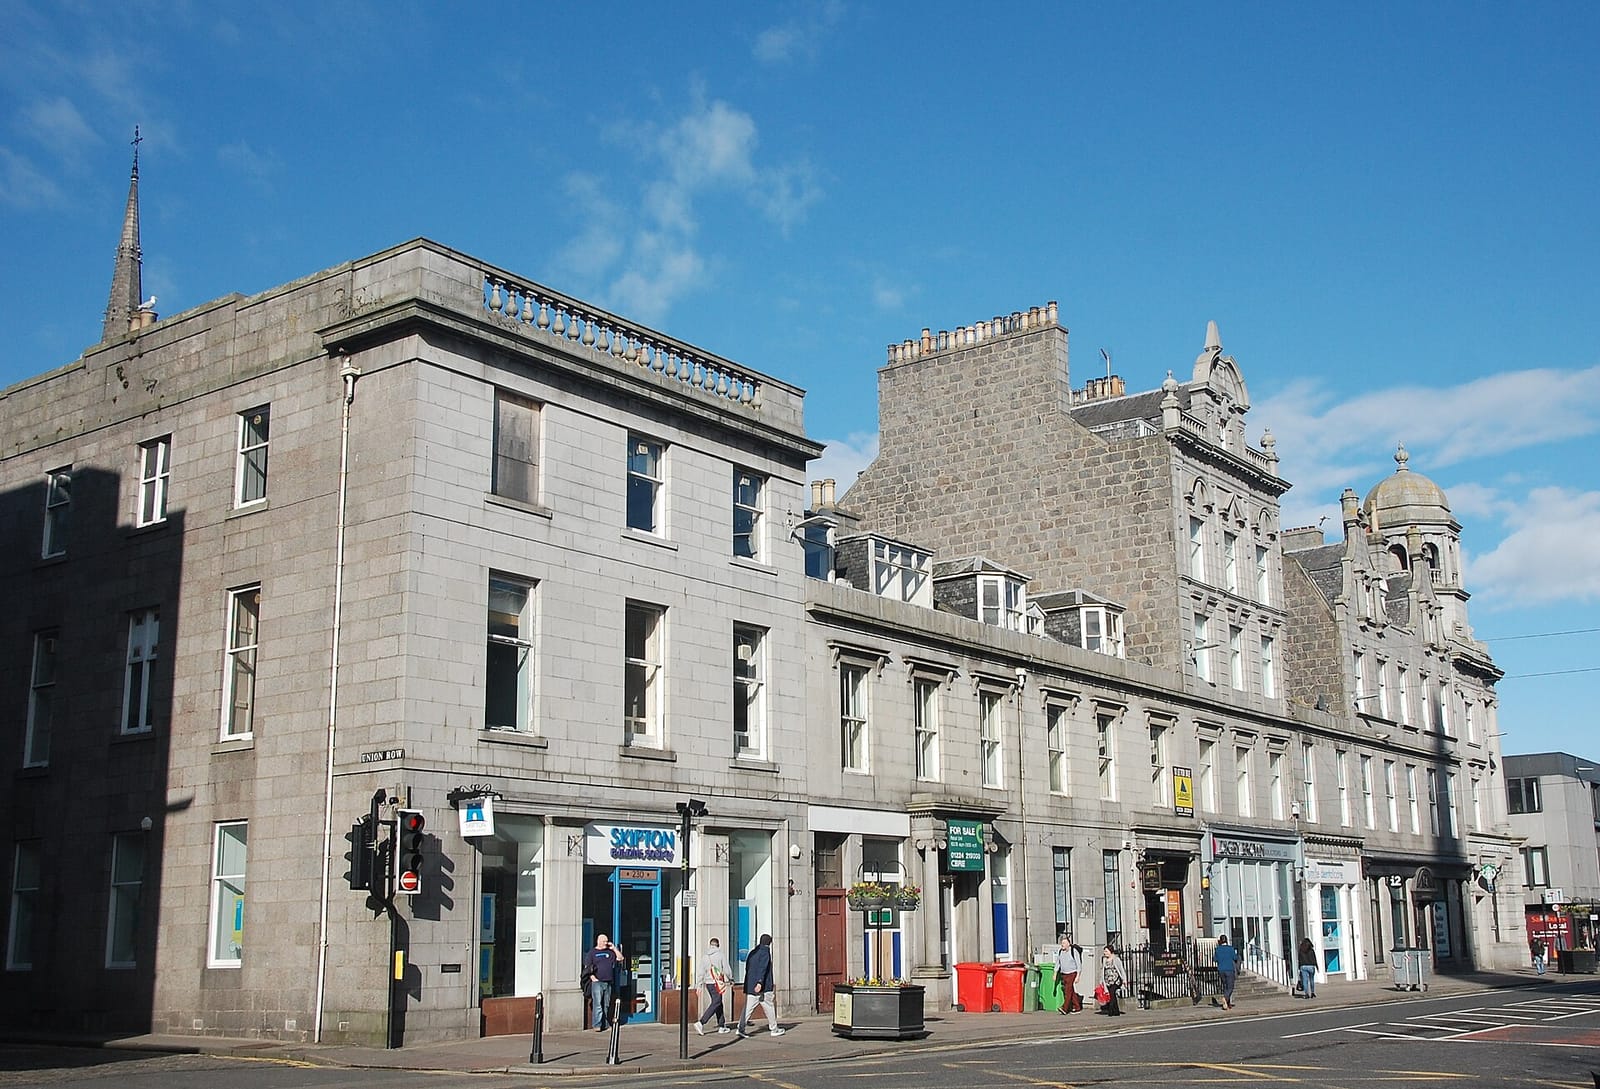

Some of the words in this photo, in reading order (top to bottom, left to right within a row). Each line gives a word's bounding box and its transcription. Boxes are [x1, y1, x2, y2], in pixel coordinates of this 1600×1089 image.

[361, 750, 384, 762] UNION
[386, 749, 403, 760] ROW
[950, 826, 962, 835] FOR
[962, 827, 976, 836] SALE
[610, 828, 675, 850] SKIPTON
[632, 870, 644, 878] 230
[1390, 875, 1402, 886] i2
